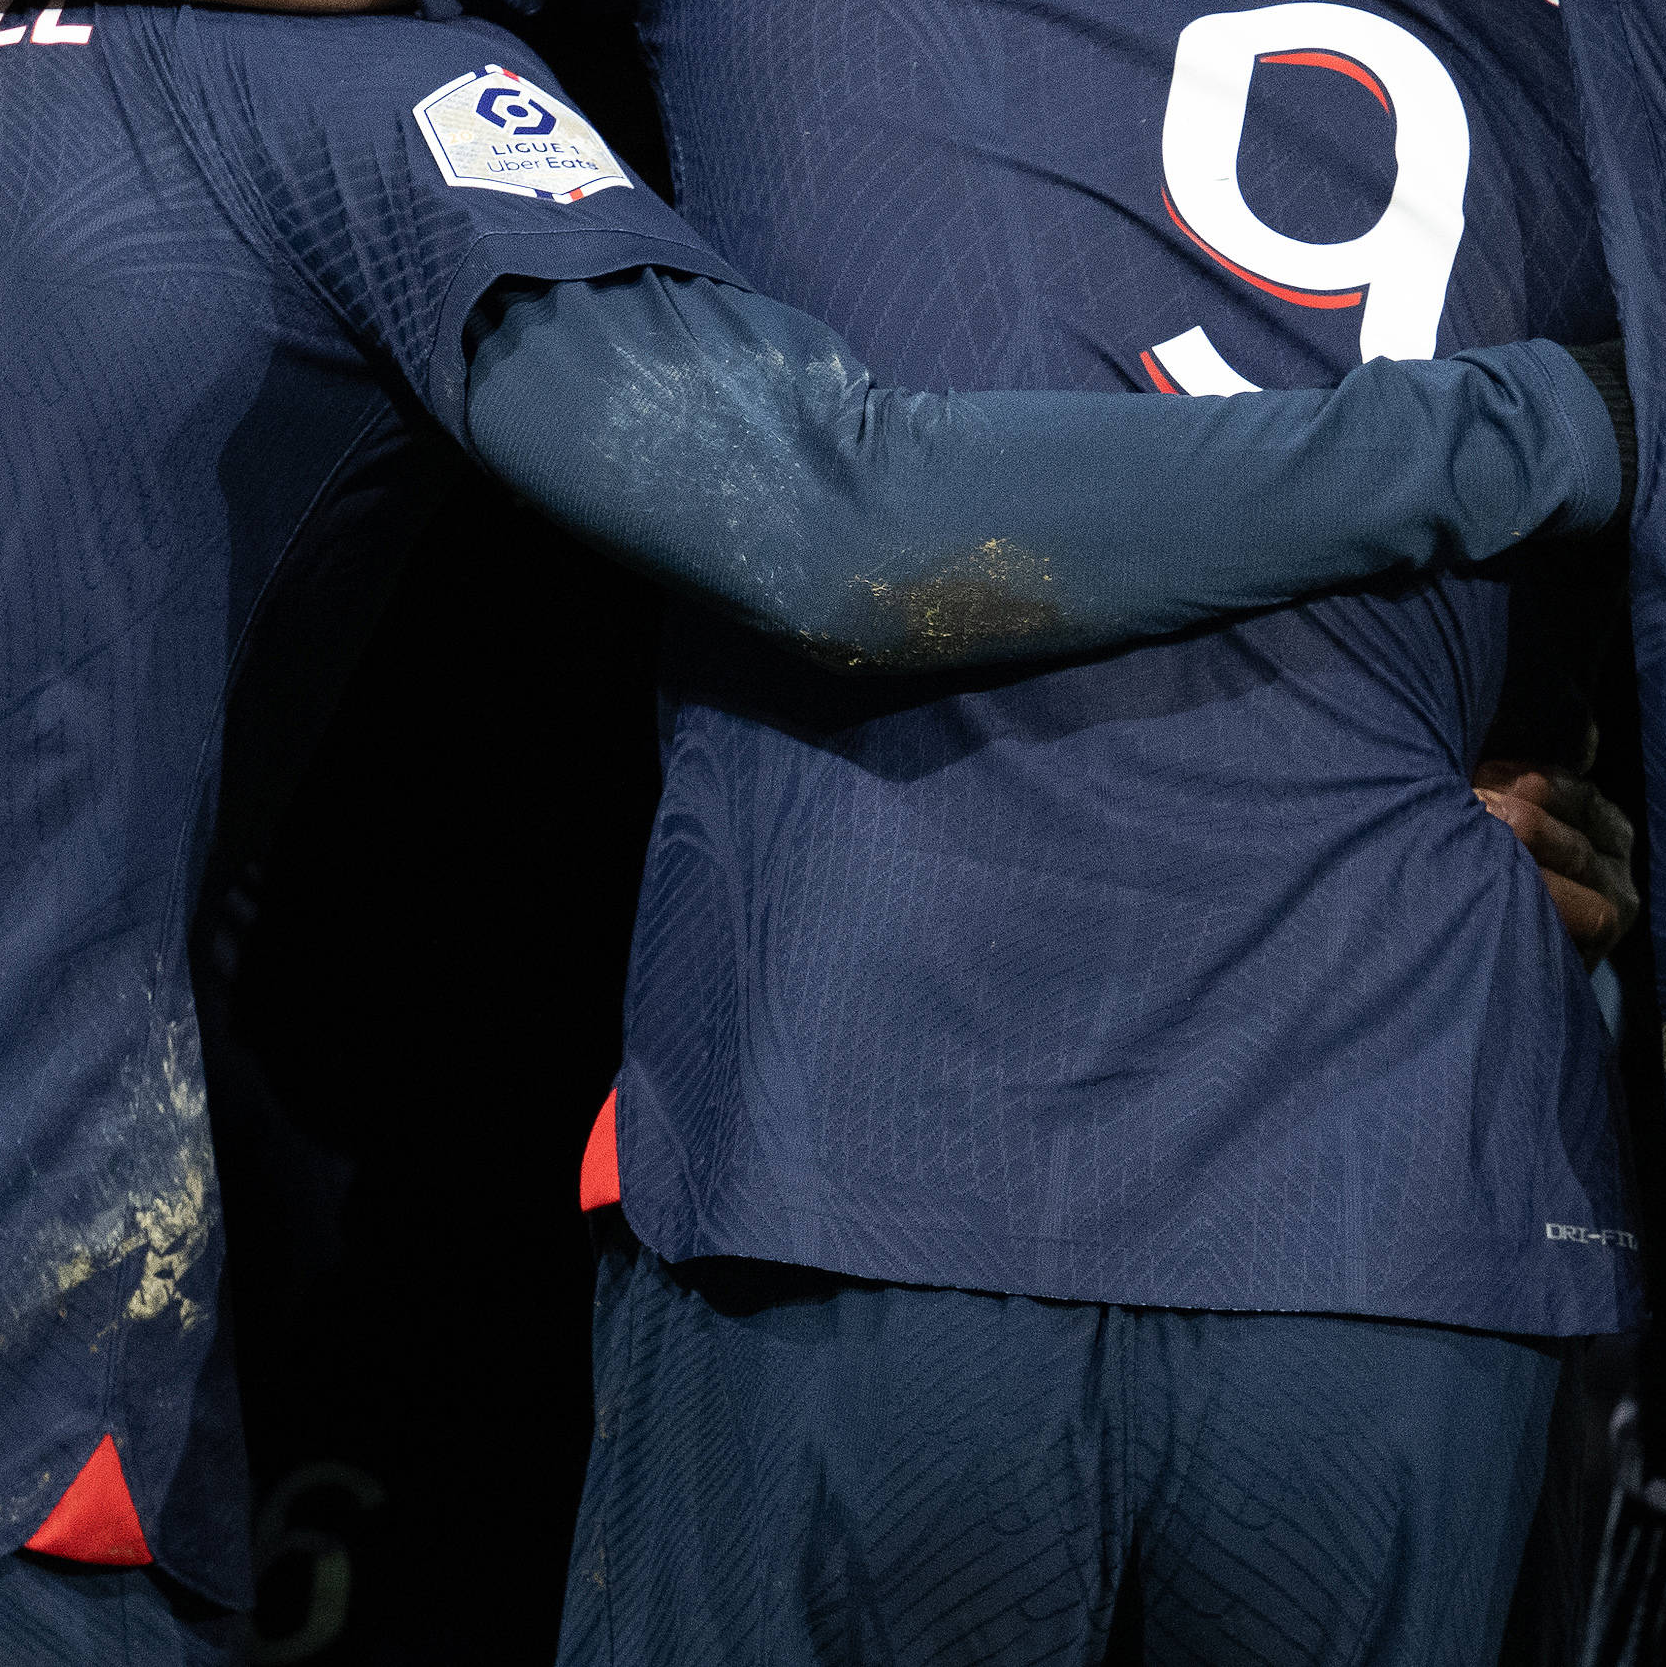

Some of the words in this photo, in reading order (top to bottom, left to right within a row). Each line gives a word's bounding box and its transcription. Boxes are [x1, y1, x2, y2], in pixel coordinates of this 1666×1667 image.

[490, 141, 566, 156] LIGUE
[486, 158, 541, 173] Uber
[544, 155, 600, 172] Eats
[1139, 0, 1472, 399] 9
